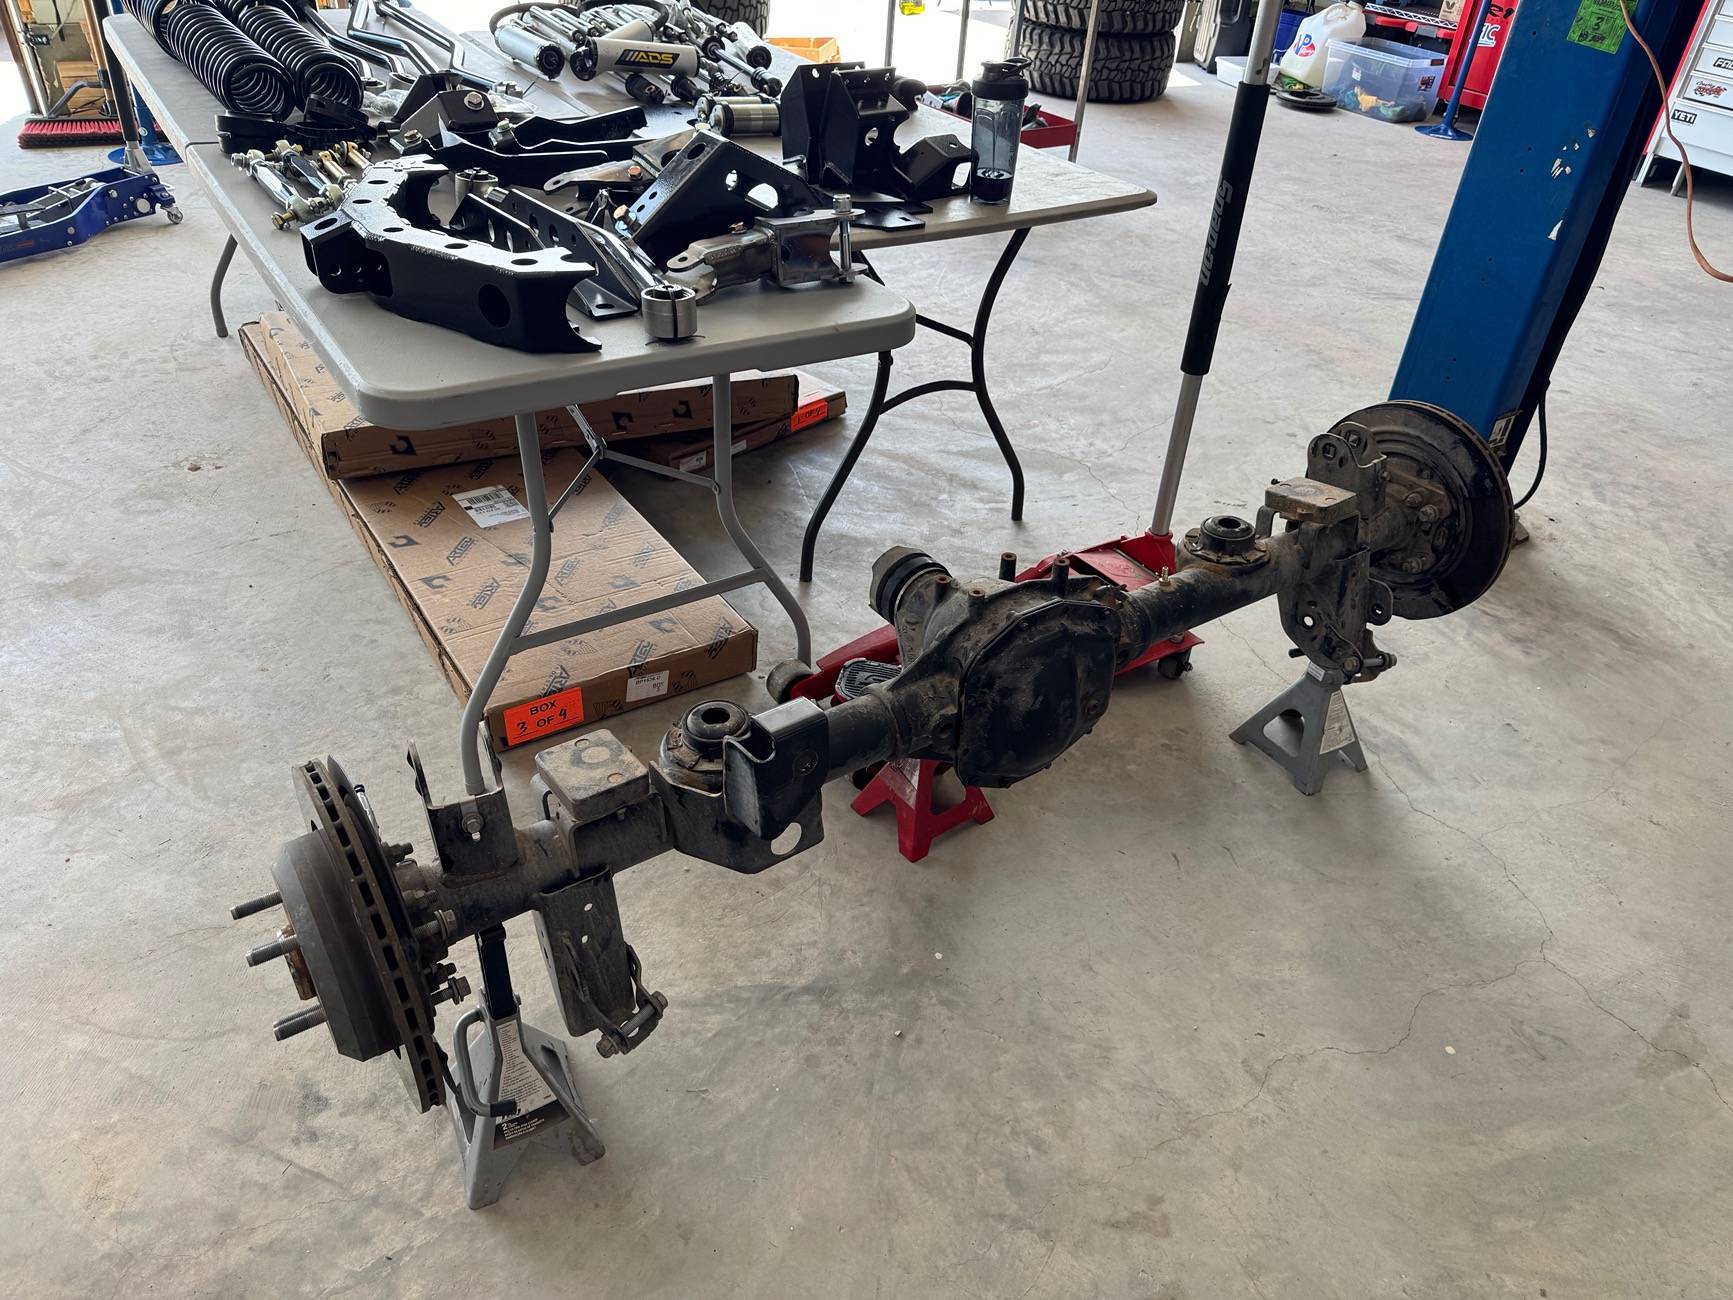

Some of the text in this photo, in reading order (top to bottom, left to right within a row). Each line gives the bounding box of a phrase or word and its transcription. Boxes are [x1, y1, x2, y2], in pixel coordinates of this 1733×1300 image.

[635, 51, 674, 65] ADS
[1673, 110, 1696, 124] YETI
[447, 536, 474, 566] ARTEC
[529, 700, 558, 716] BOX
[517, 708, 568, 736] 3 OF 4
